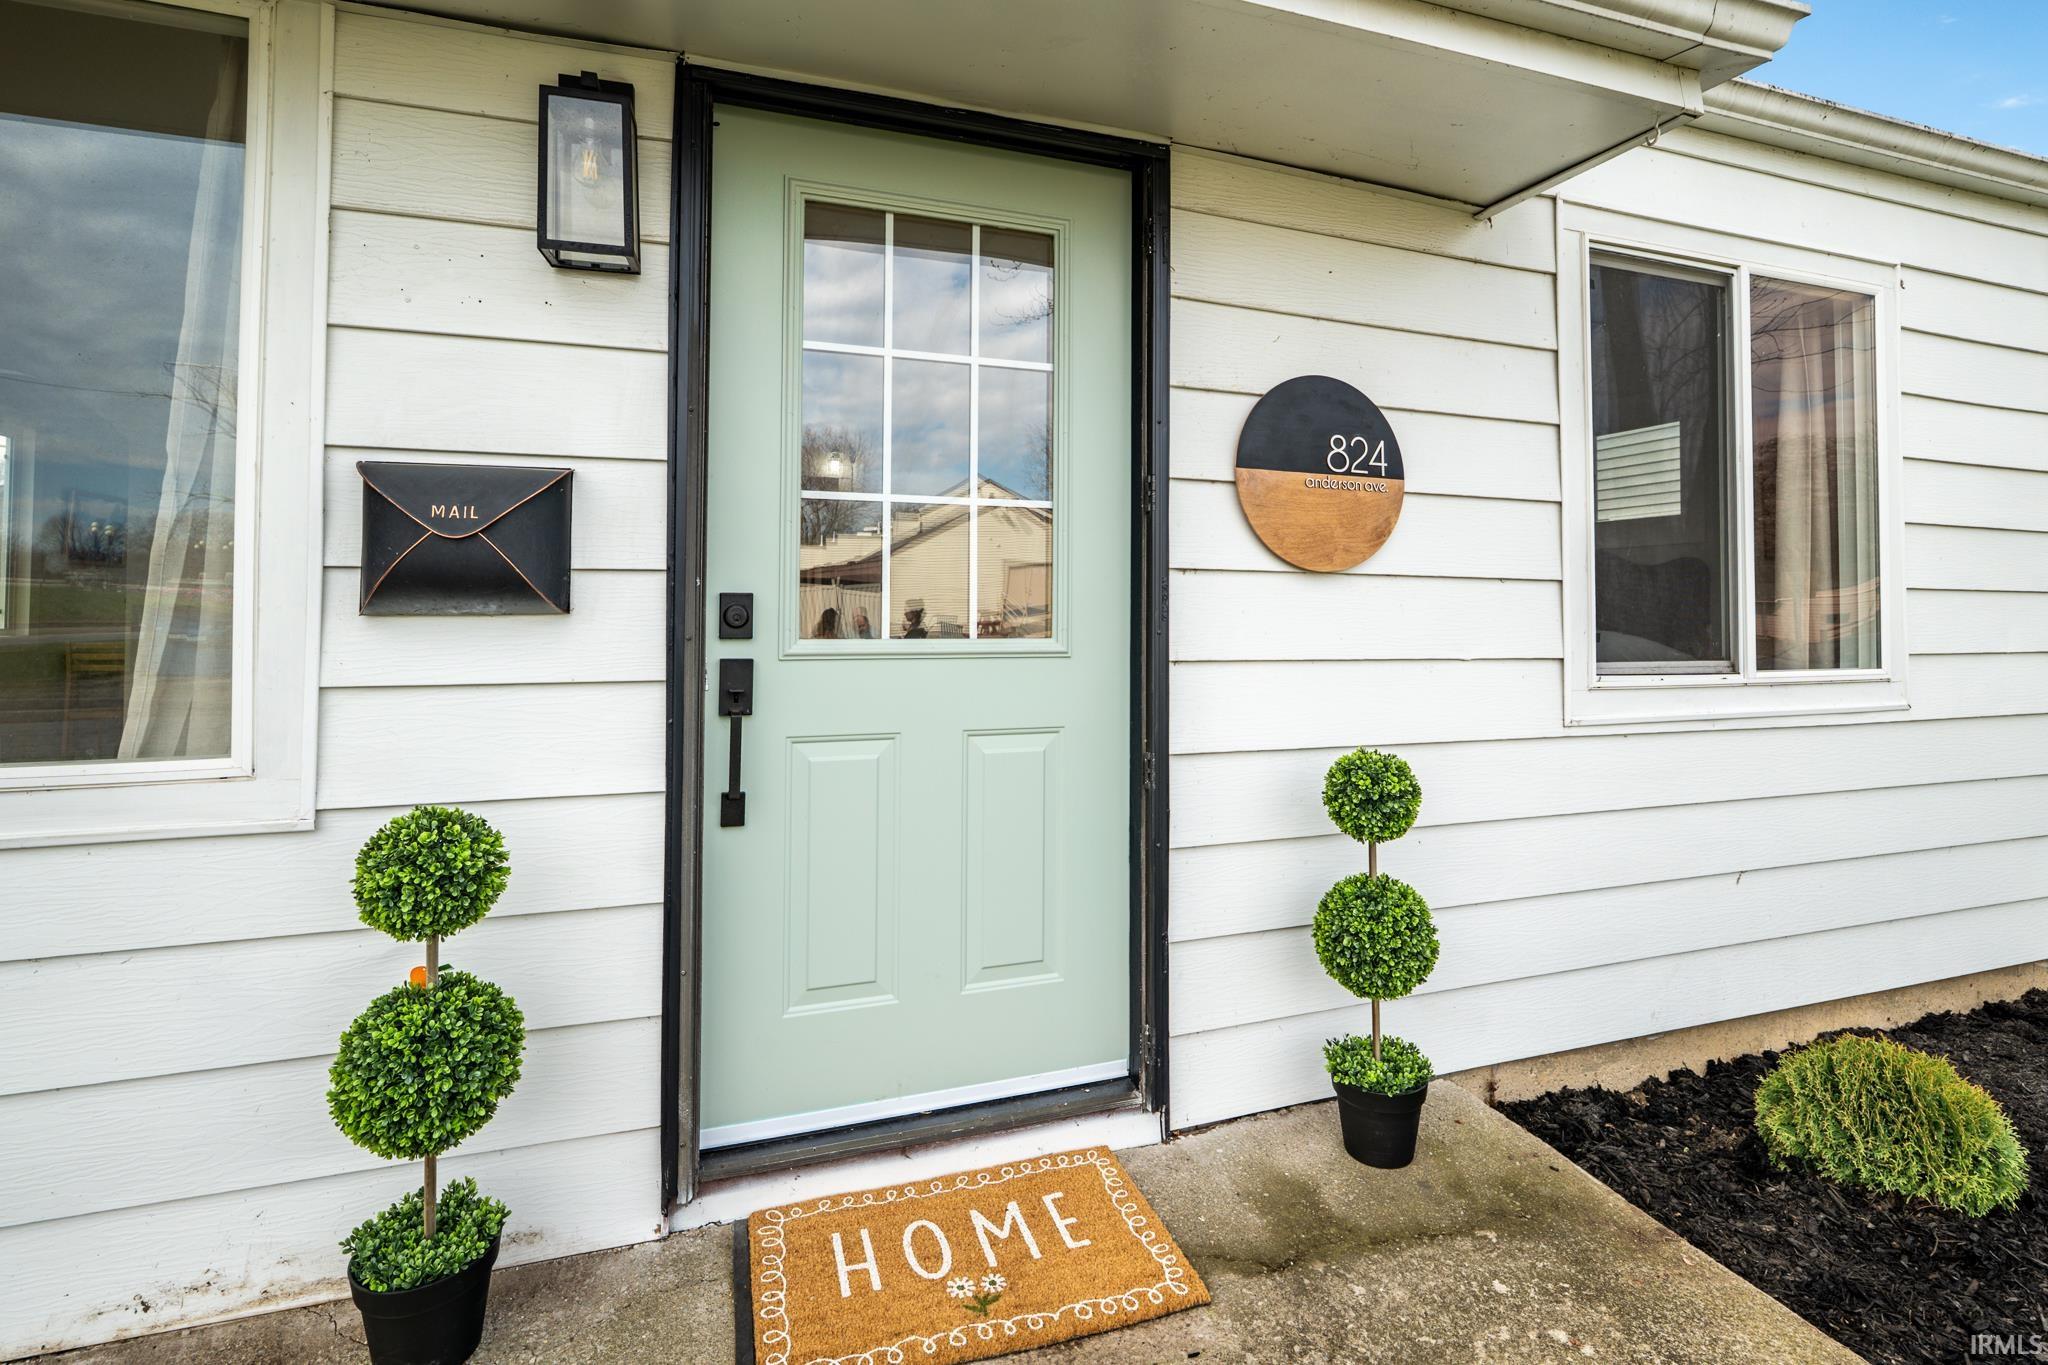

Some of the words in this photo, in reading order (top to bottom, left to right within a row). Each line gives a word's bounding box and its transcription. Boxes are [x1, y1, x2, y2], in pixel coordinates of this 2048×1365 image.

[1327, 434, 1388, 477] 824
[1304, 476, 1362, 491] anderson
[1364, 481, 1389, 493] ave.
[431, 504, 479, 519] MAIL
[831, 1191, 1092, 1298] HOME
